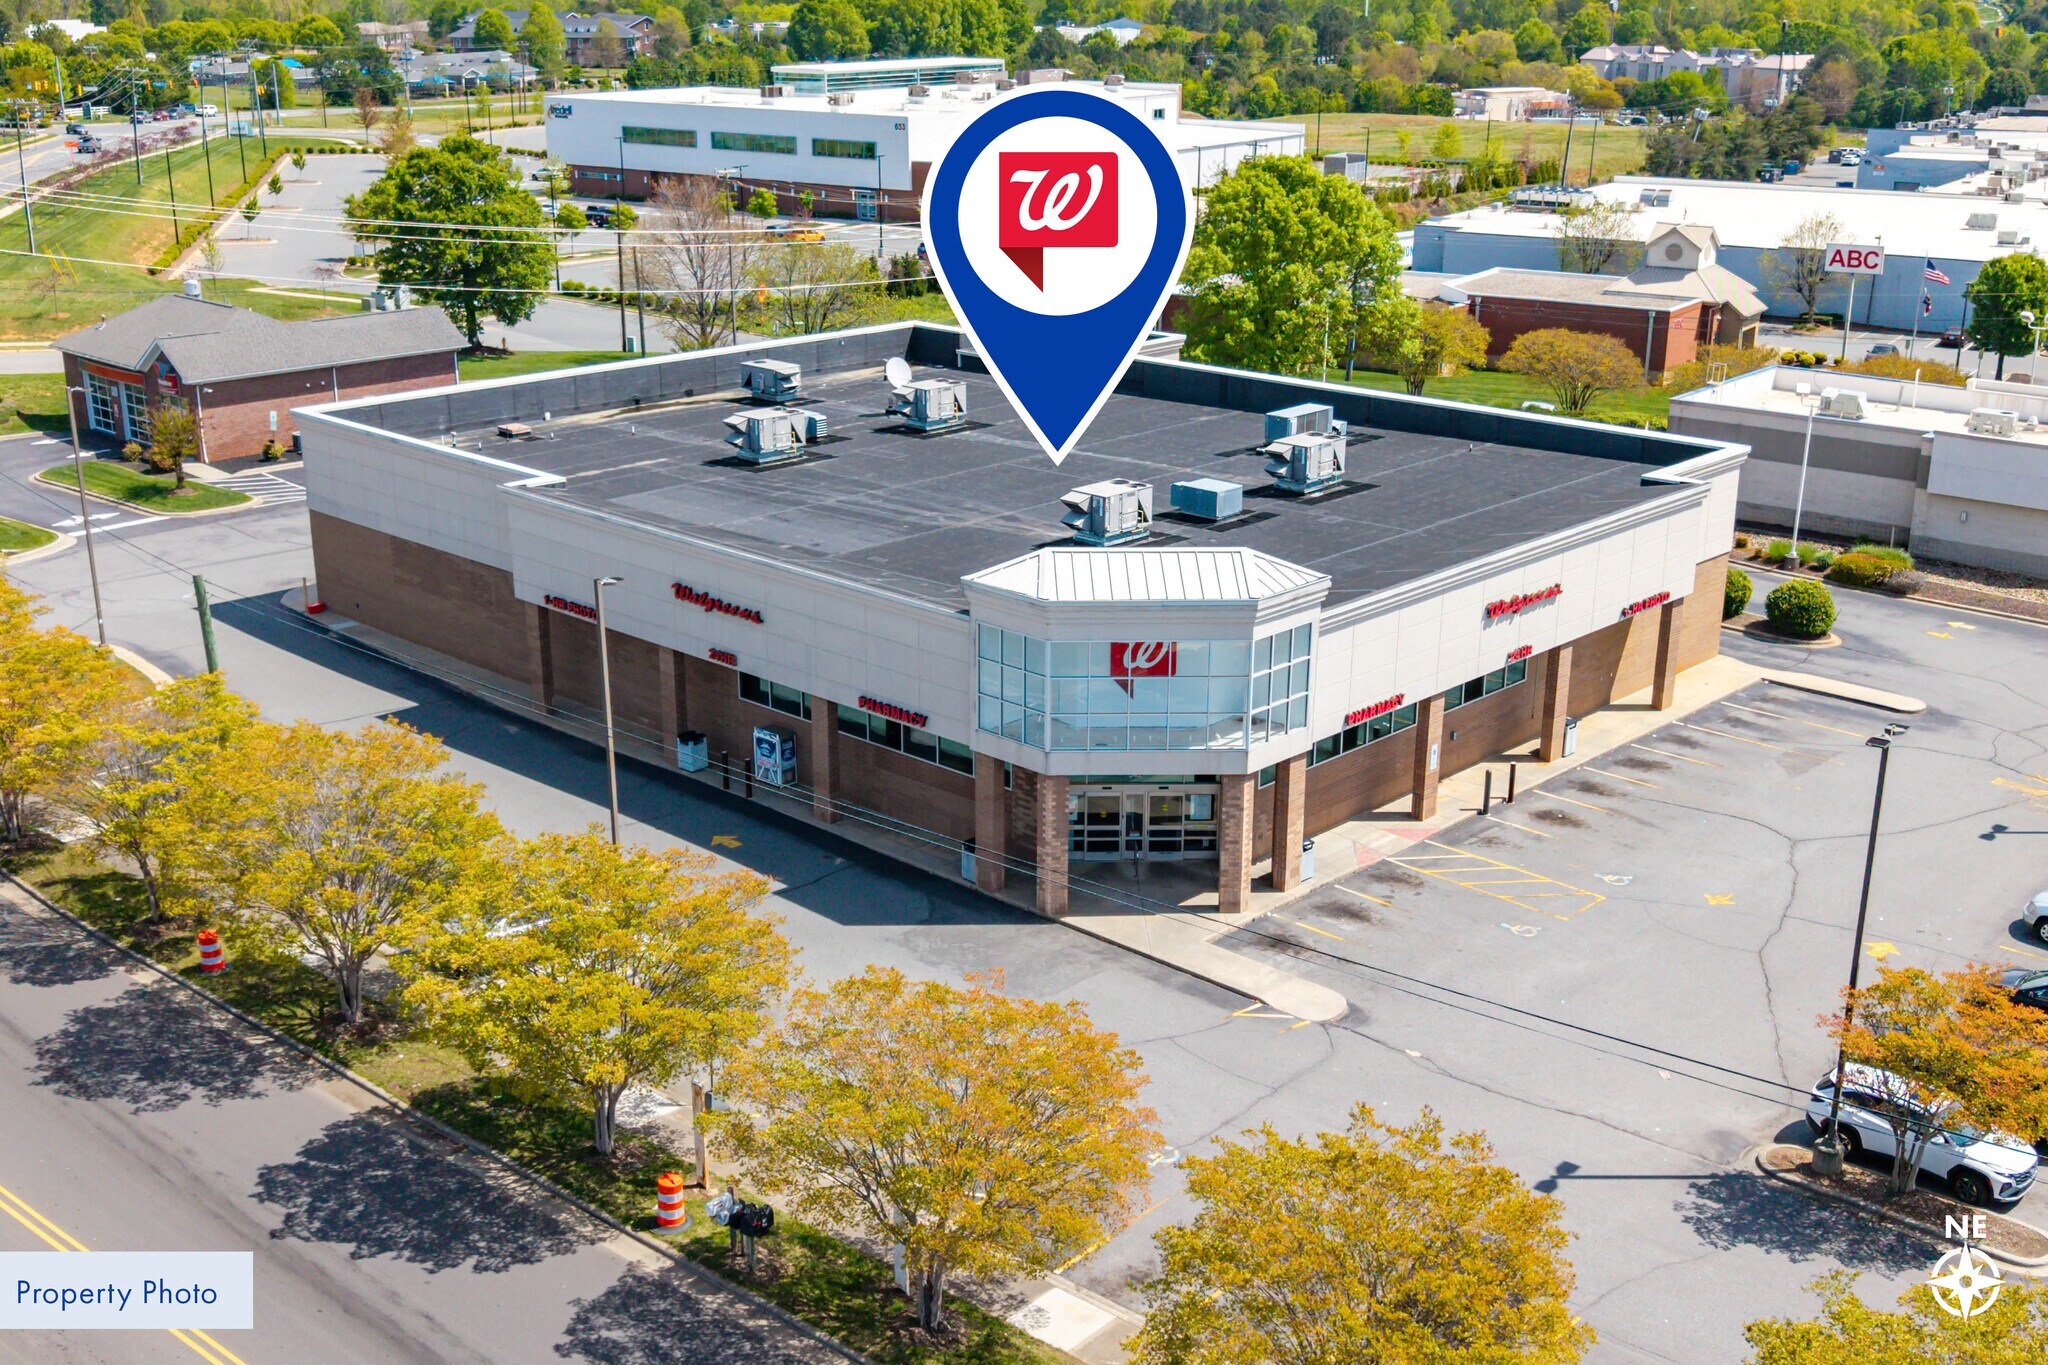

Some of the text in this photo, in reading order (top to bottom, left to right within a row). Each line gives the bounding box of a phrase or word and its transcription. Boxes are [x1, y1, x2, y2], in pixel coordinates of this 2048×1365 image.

[894, 122, 906, 131] 653
[1828, 249, 1880, 270] ABC
[671, 582, 764, 625] Walgreens
[1486, 583, 1563, 619] Walgreens
[1643, 591, 1671, 609] PHOTO
[857, 696, 928, 728] PHARMACY
[1346, 693, 1406, 726] PHARMACY
